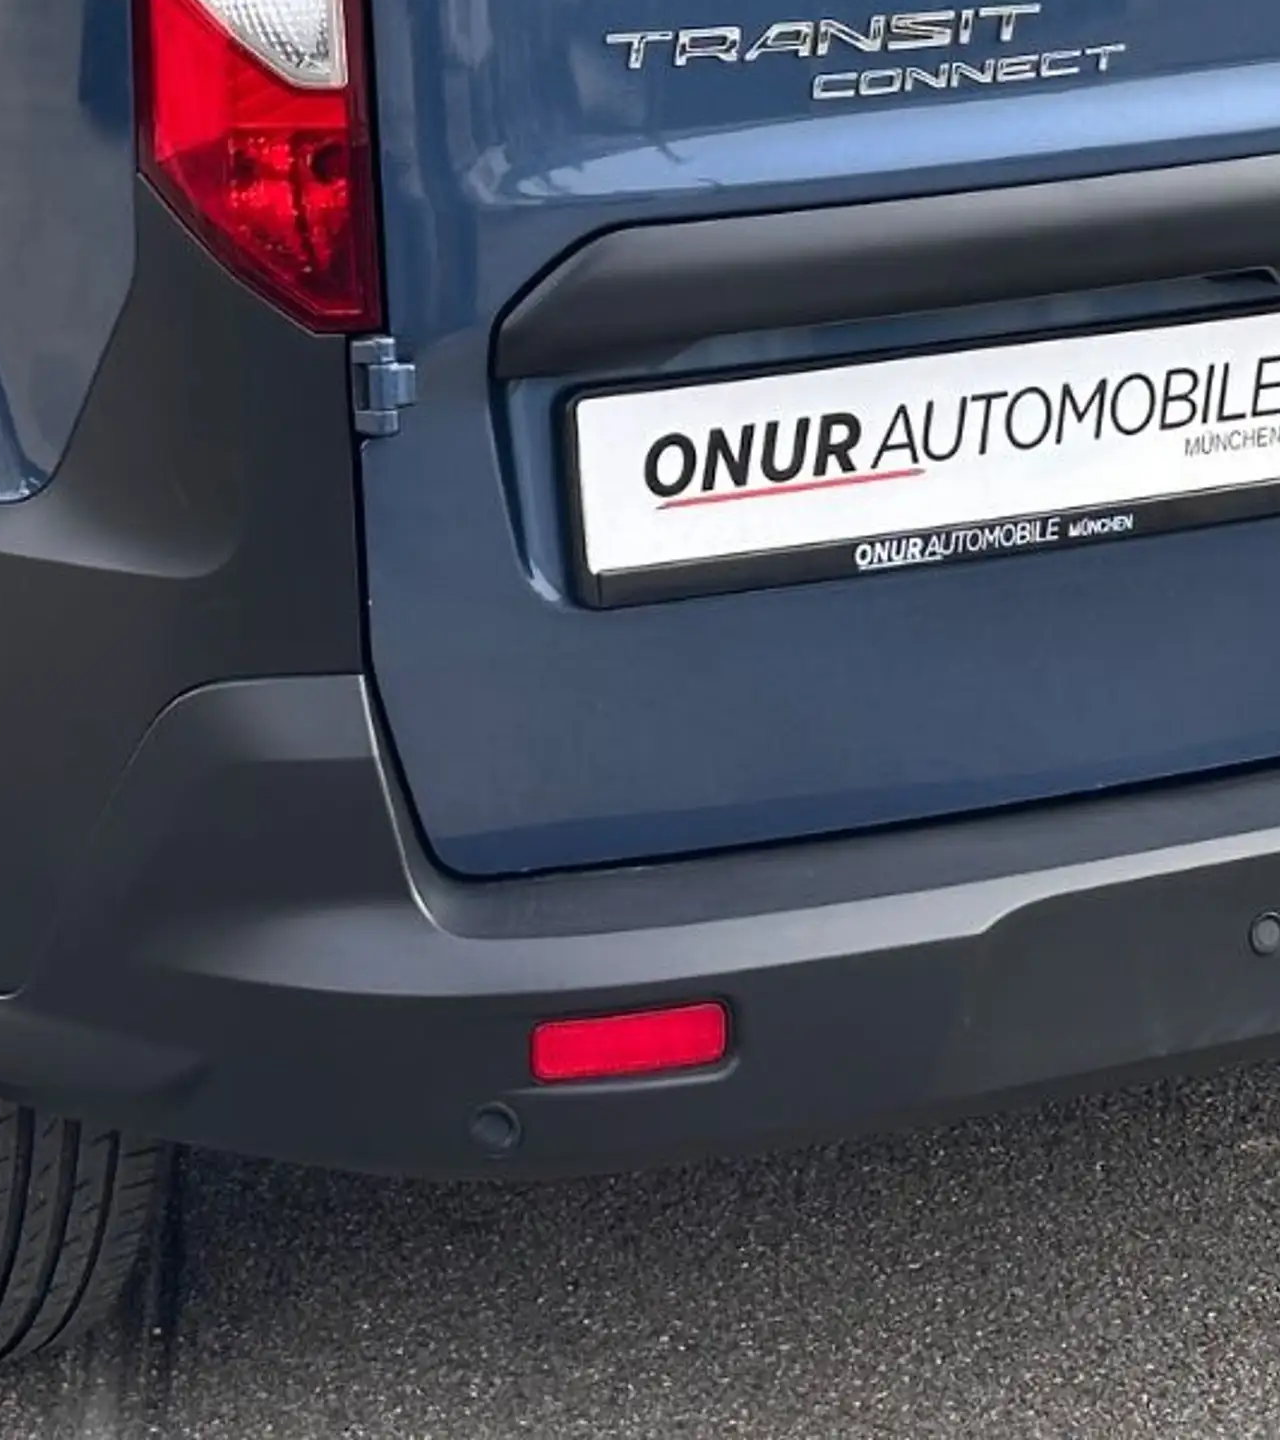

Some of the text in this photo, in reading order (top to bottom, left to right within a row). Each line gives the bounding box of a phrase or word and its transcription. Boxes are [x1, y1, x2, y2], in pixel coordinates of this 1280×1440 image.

[606, 2, 1042, 70] TRANSIT
[812, 43, 1127, 101] CONNECT
[643, 412, 863, 498] ONUR
[854, 537, 924, 567] ONUR
[922, 517, 1062, 559] AUTOMOBILE
